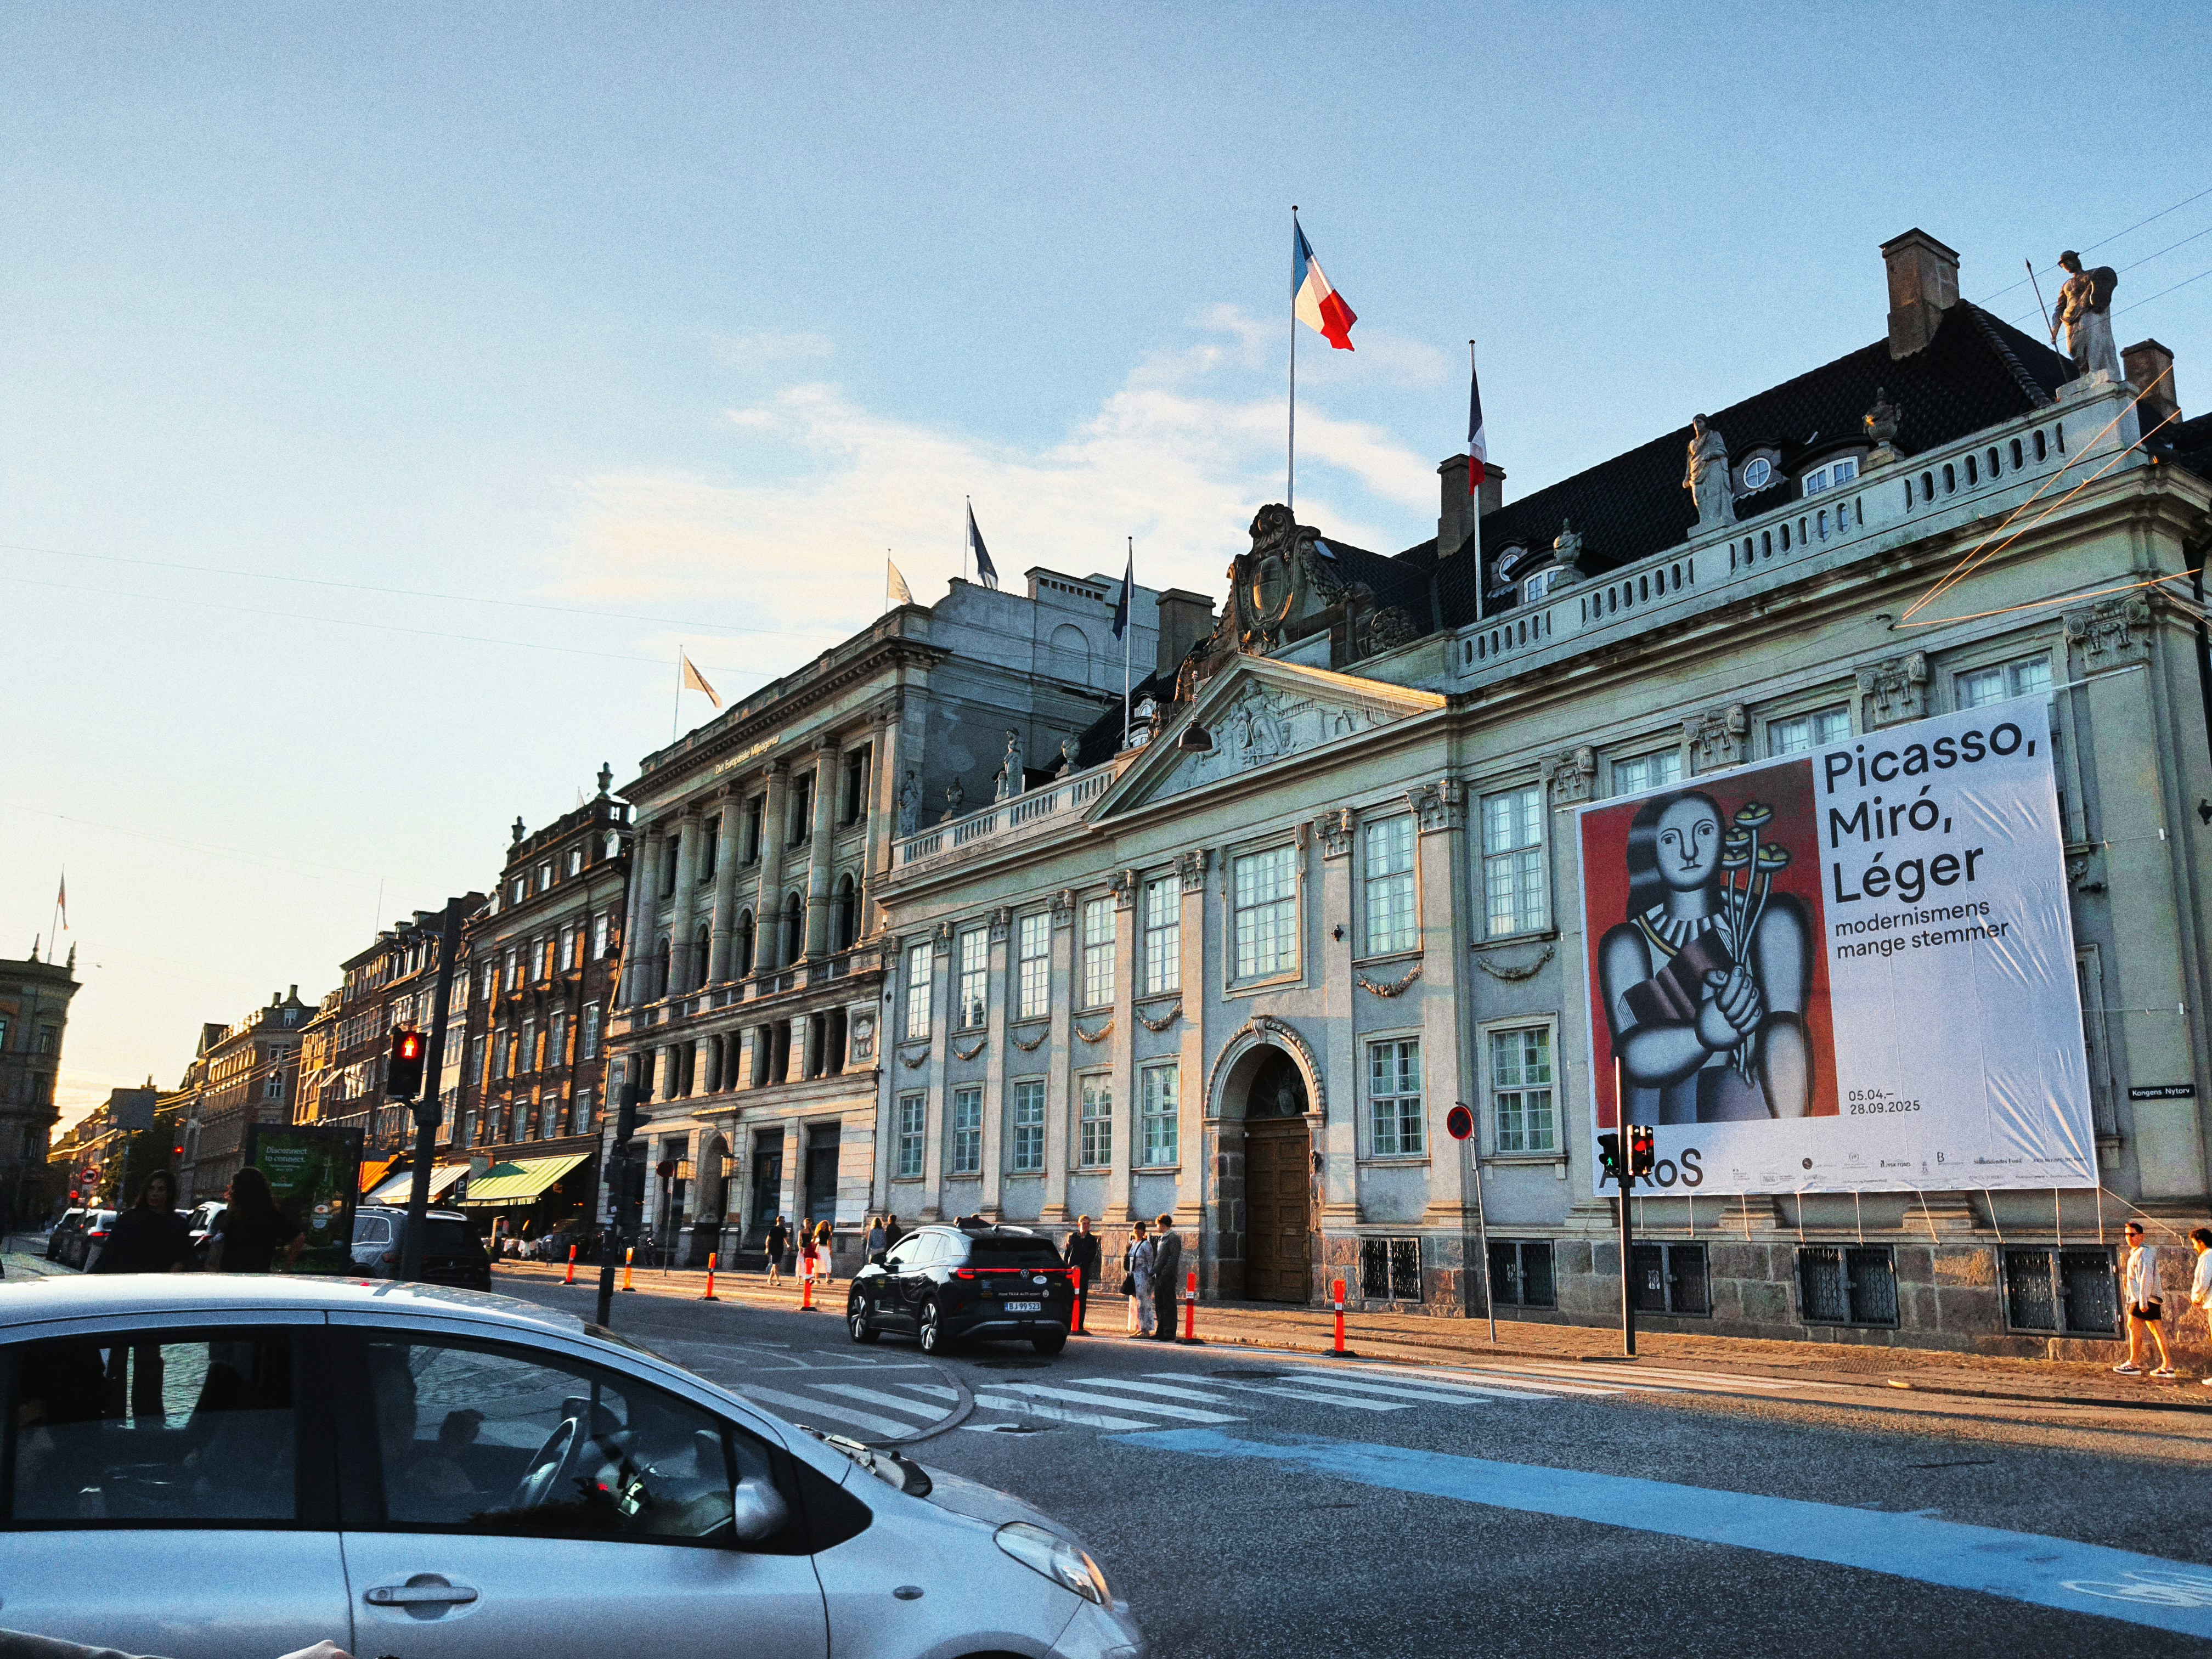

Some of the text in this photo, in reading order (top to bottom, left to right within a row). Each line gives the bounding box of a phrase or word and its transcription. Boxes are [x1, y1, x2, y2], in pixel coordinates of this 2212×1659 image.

[1825, 723, 2036, 794] Picasso,
[1829, 785, 1951, 848] Miró,
[1833, 847, 1984, 903] Léger
[1836, 901, 1990, 936] modernismens
[1838, 922, 2009, 959] mange stemmer
[1850, 1100, 1920, 1115] 28.09.2025
[266, 1146, 307, 1154] Disconnect
[458, 1181, 465, 1190] P
